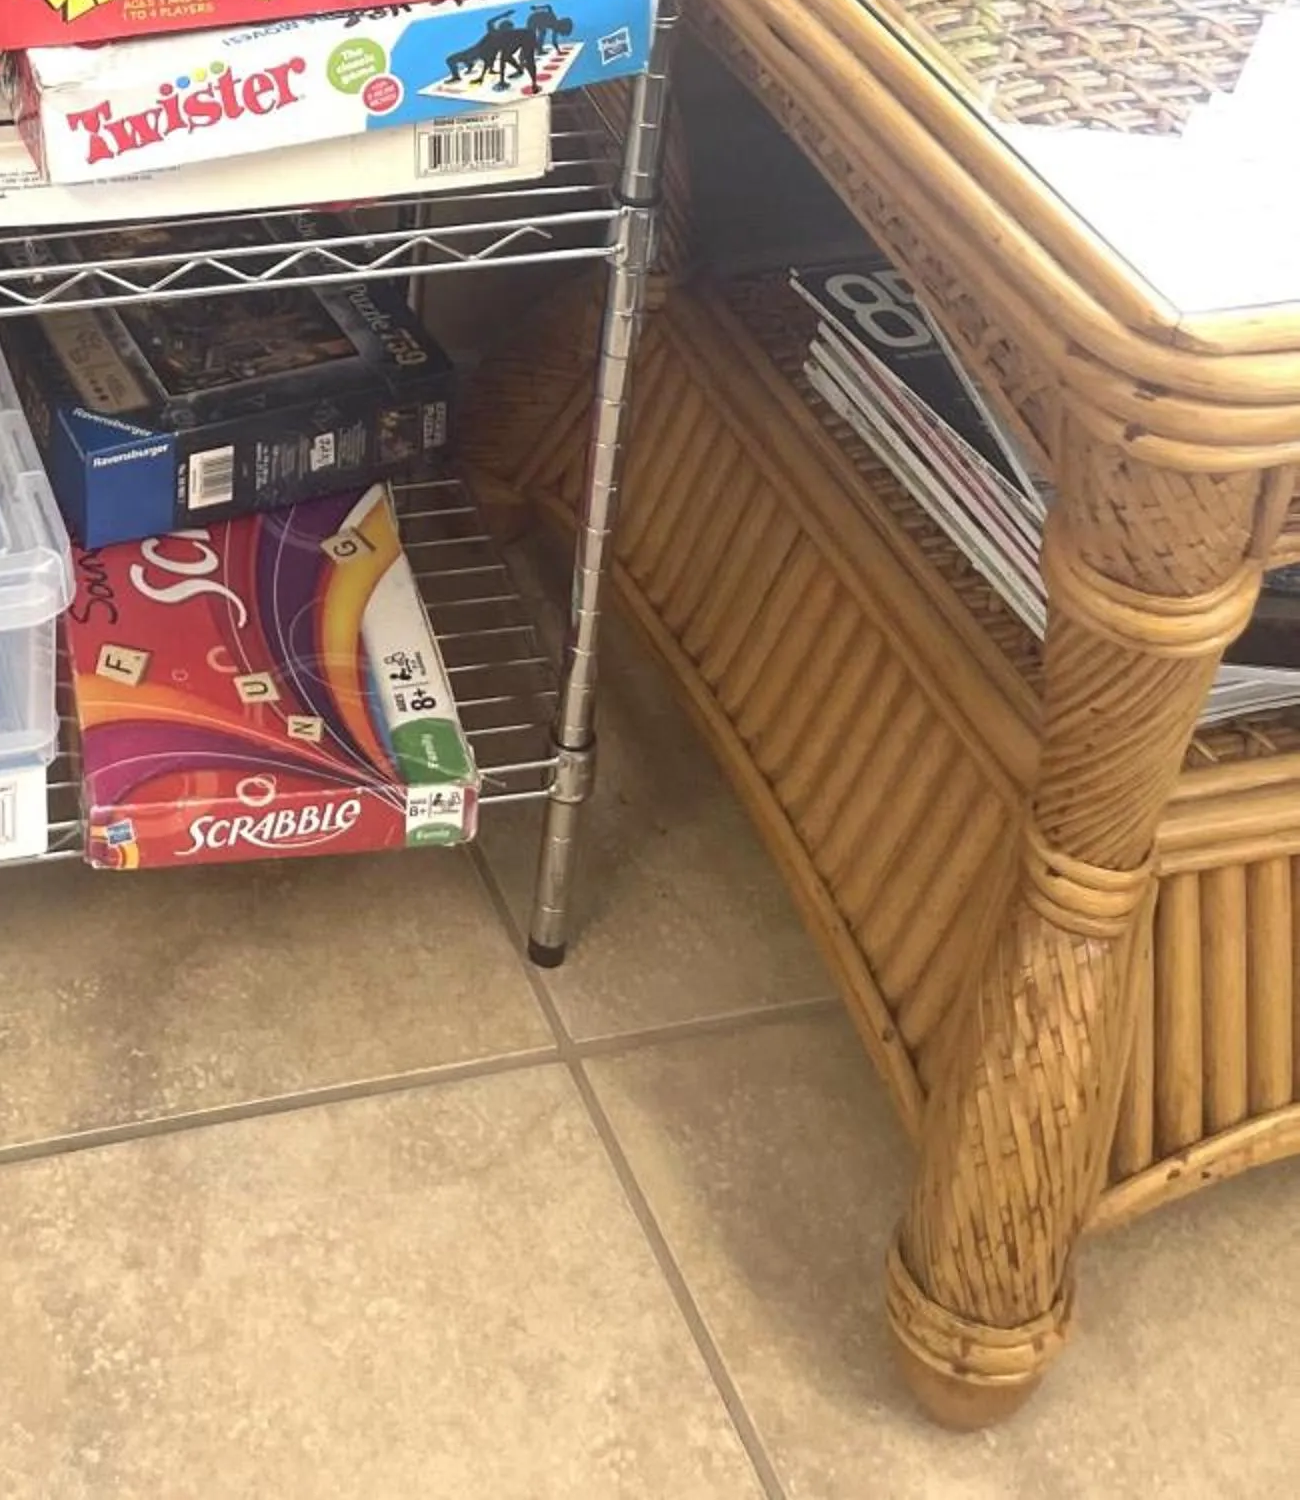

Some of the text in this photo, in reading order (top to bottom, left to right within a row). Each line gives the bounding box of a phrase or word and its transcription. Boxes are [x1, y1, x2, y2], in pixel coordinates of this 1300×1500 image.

[130, 9, 147, 21] TO
[159, 2, 217, 17] PLAYERS
[335, 53, 375, 75] classic
[340, 47, 364, 61] The
[66, 54, 307, 165] Twister
[345, 283, 390, 334] Puzzle
[71, 406, 153, 438] Ravensburger
[91, 442, 170, 469] Ravensburger
[104, 653, 135, 676] F
[241, 680, 270, 698] U
[410, 687, 437, 712] 8+
